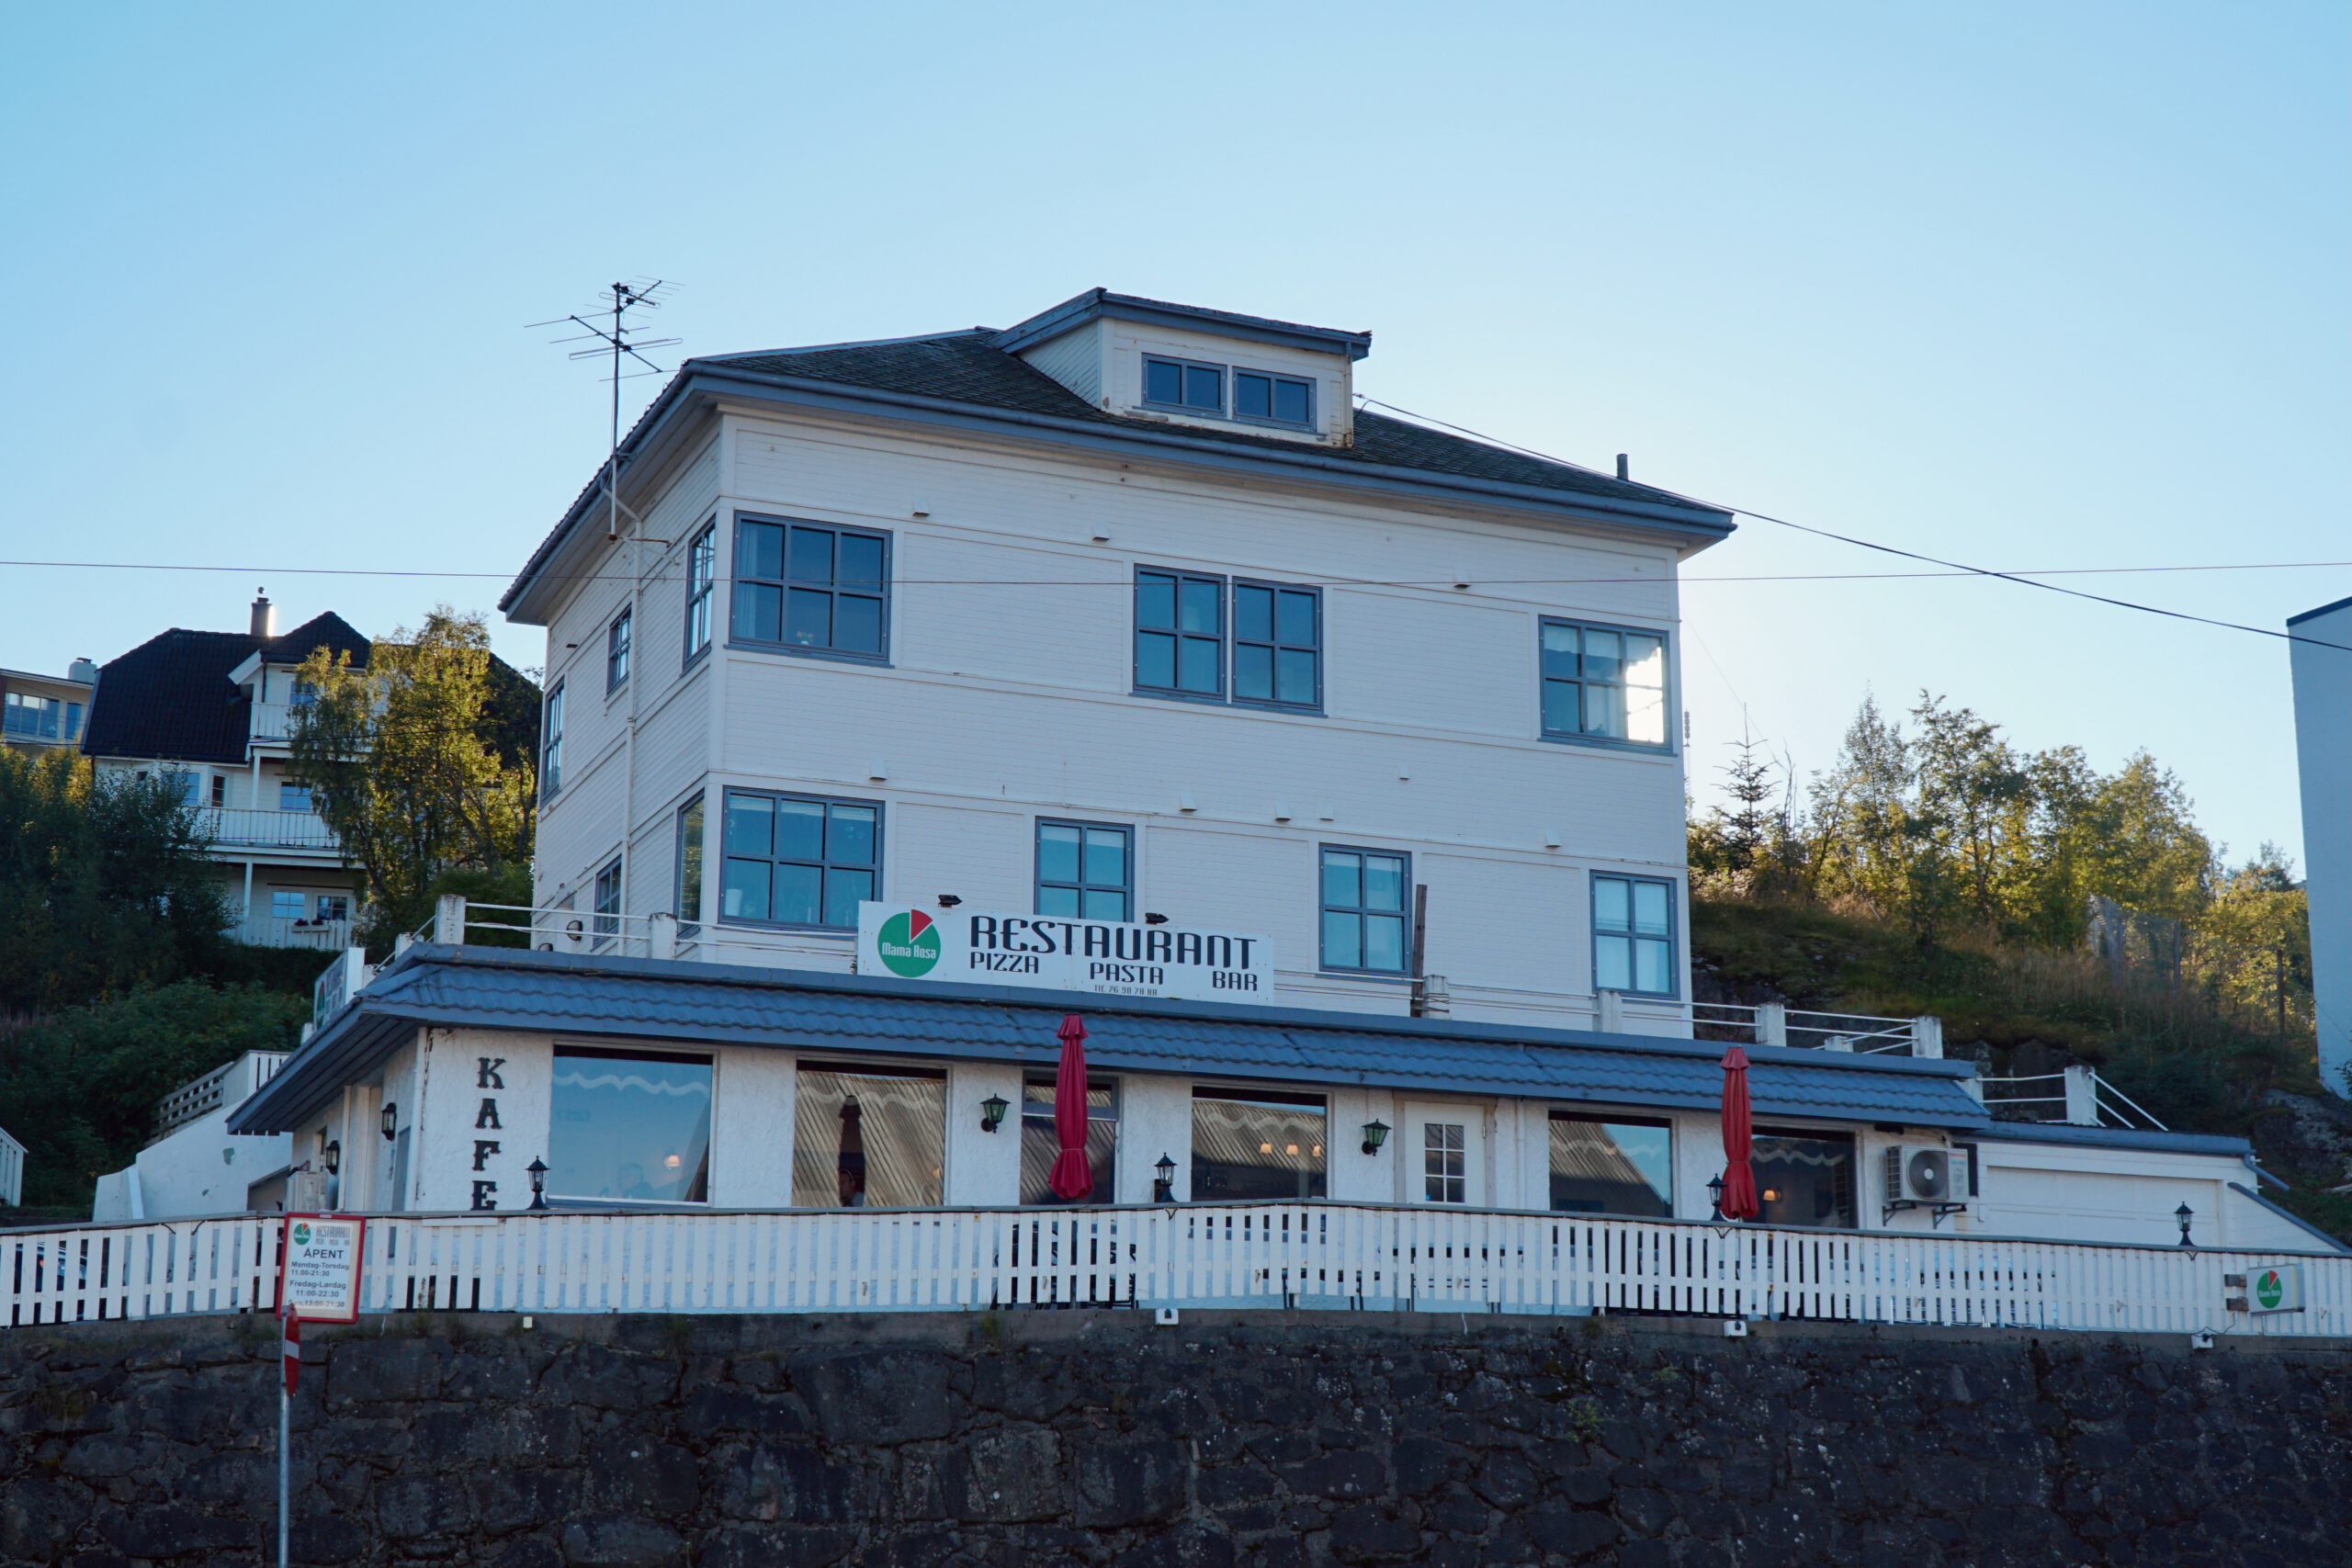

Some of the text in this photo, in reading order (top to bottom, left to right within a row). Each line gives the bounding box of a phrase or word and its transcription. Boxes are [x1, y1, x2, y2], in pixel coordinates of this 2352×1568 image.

[882, 942, 936, 959] Mama Rosa
[970, 916, 1257, 970] RESTAURANT
[970, 951, 1258, 991] PIZZA PASTA BAR
[470, 1056, 506, 1210] KAFE
[303, 1247, 345, 1259] ÅPENT
